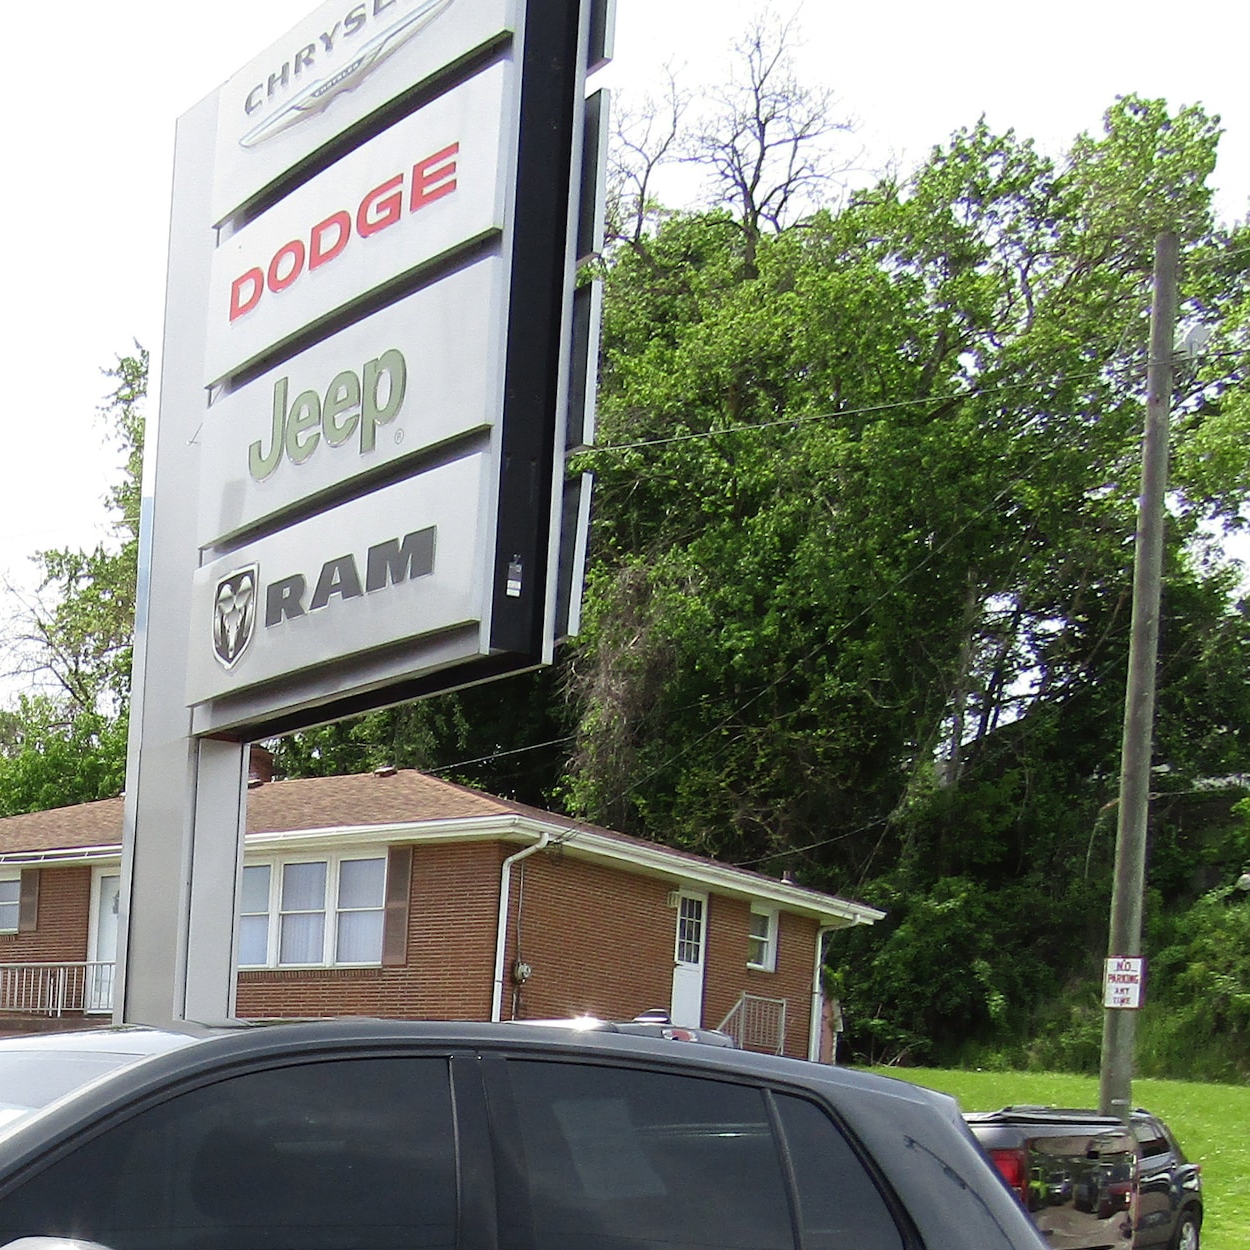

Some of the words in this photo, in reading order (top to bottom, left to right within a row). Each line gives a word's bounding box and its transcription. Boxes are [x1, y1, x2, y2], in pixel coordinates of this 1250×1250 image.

[244, 0, 397, 115] CHRYSL
[229, 141, 460, 323] DODGE
[248, 348, 407, 483] Jeep
[264, 524, 438, 629] RAM
